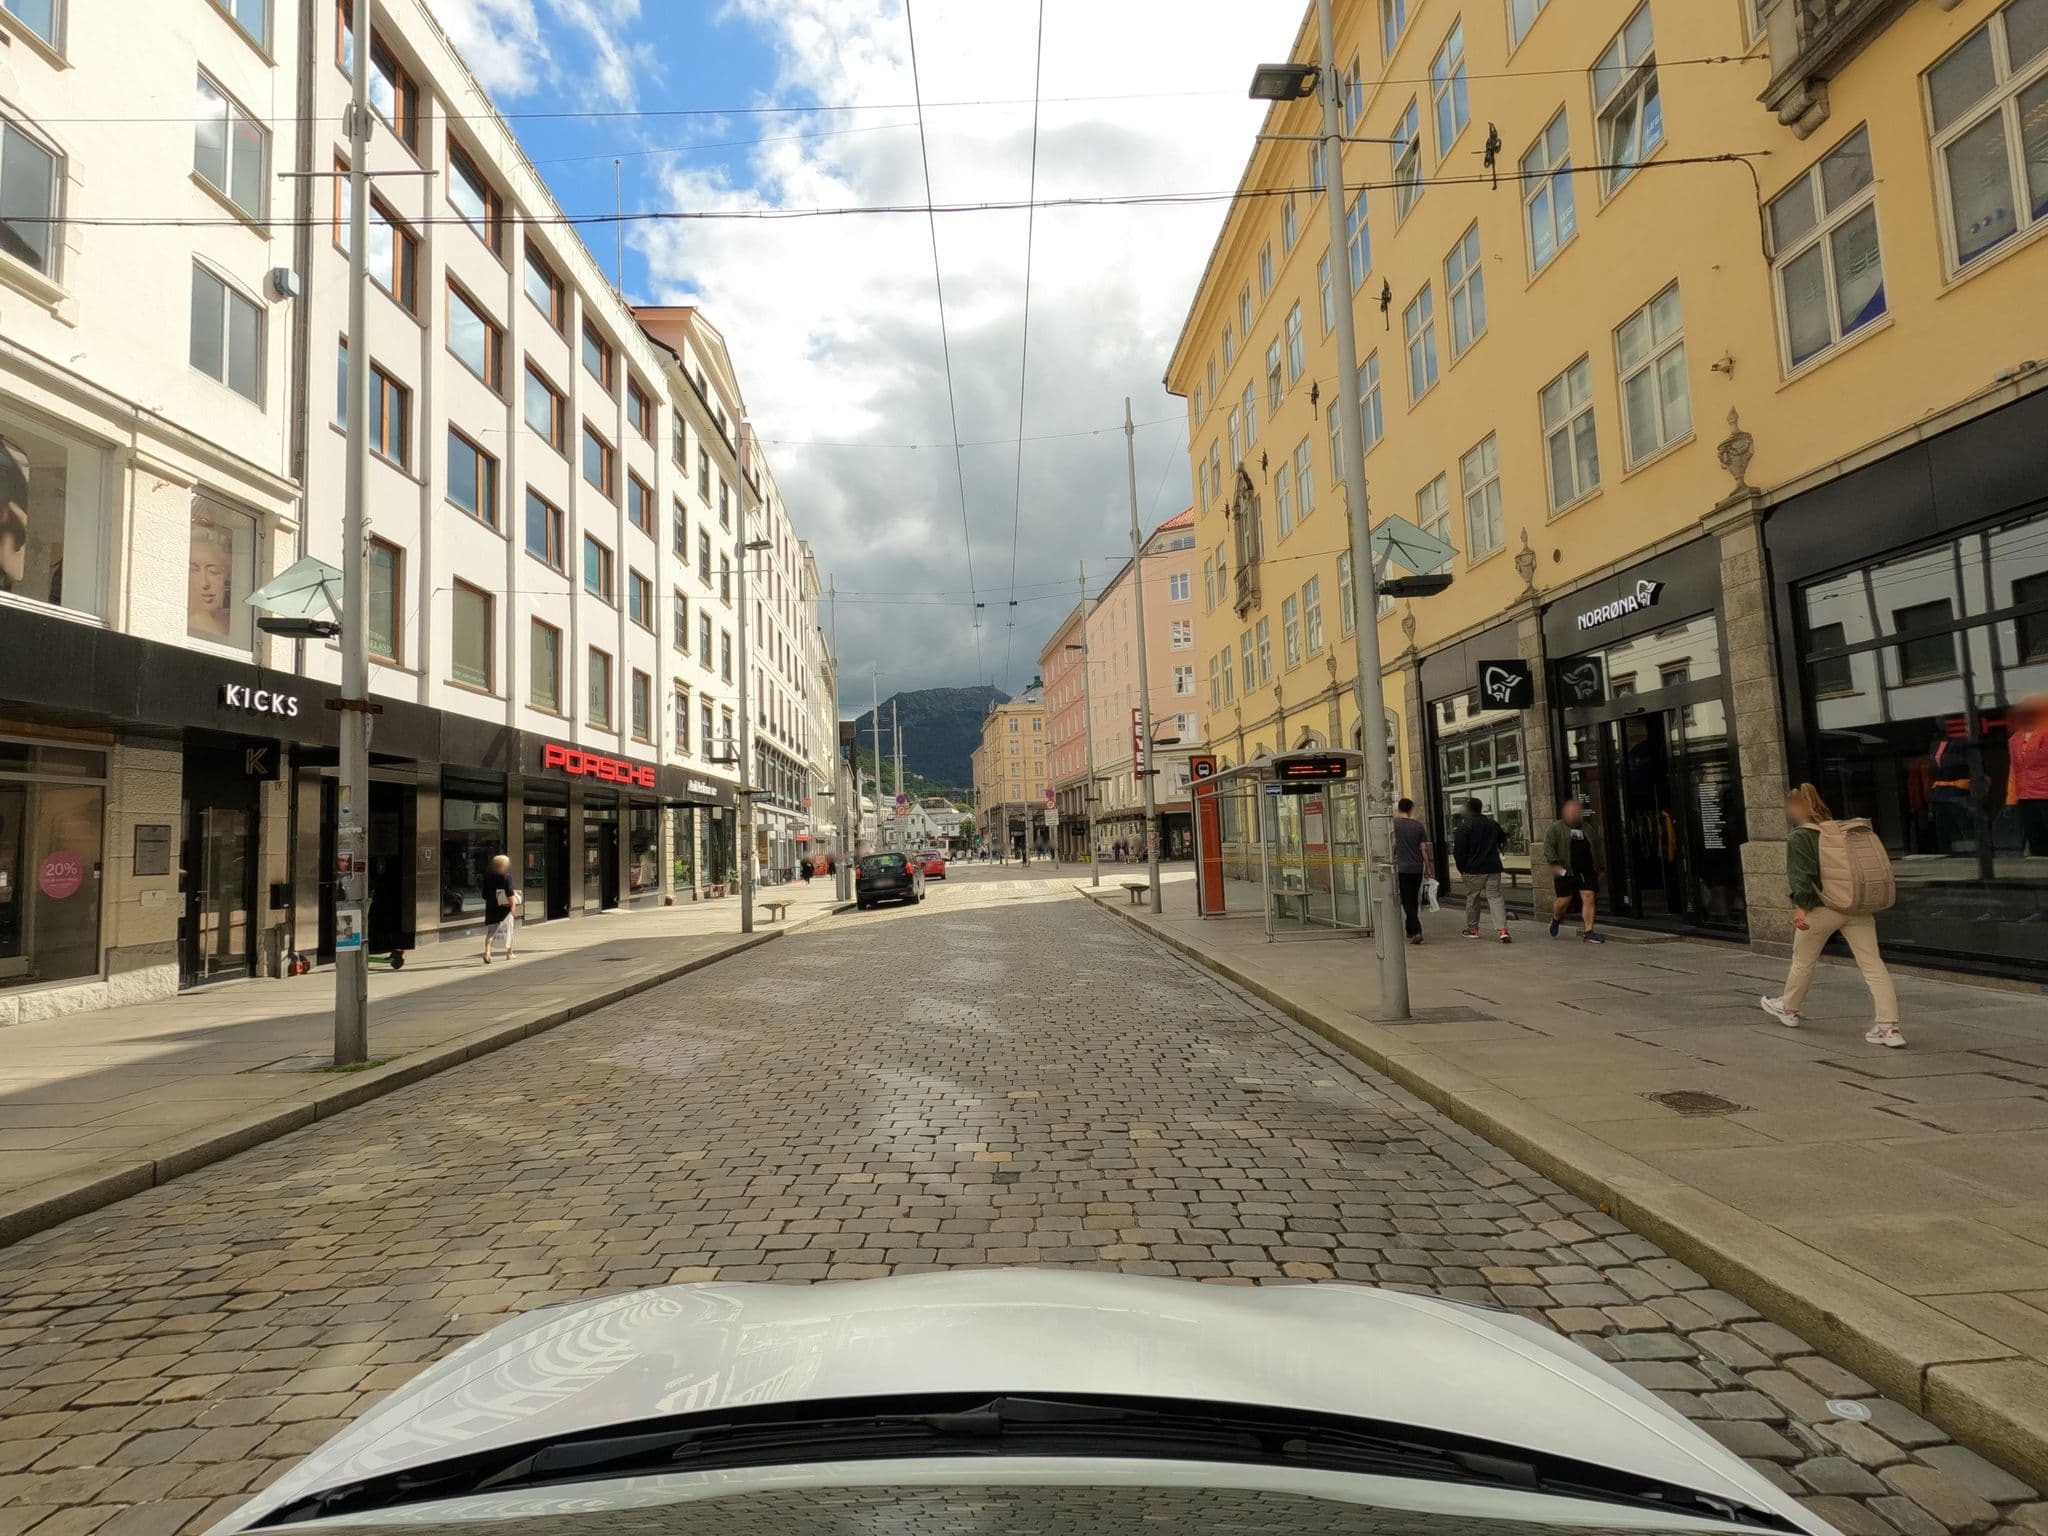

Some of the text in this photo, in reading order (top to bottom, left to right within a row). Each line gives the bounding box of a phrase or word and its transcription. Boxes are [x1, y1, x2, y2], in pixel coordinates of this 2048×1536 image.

[1577, 595, 1639, 631] NORRØNA
[226, 683, 298, 717] KICKS
[245, 747, 268, 775] K
[545, 743, 656, 788] PORSCHE
[46, 862, 78, 876] 20%
